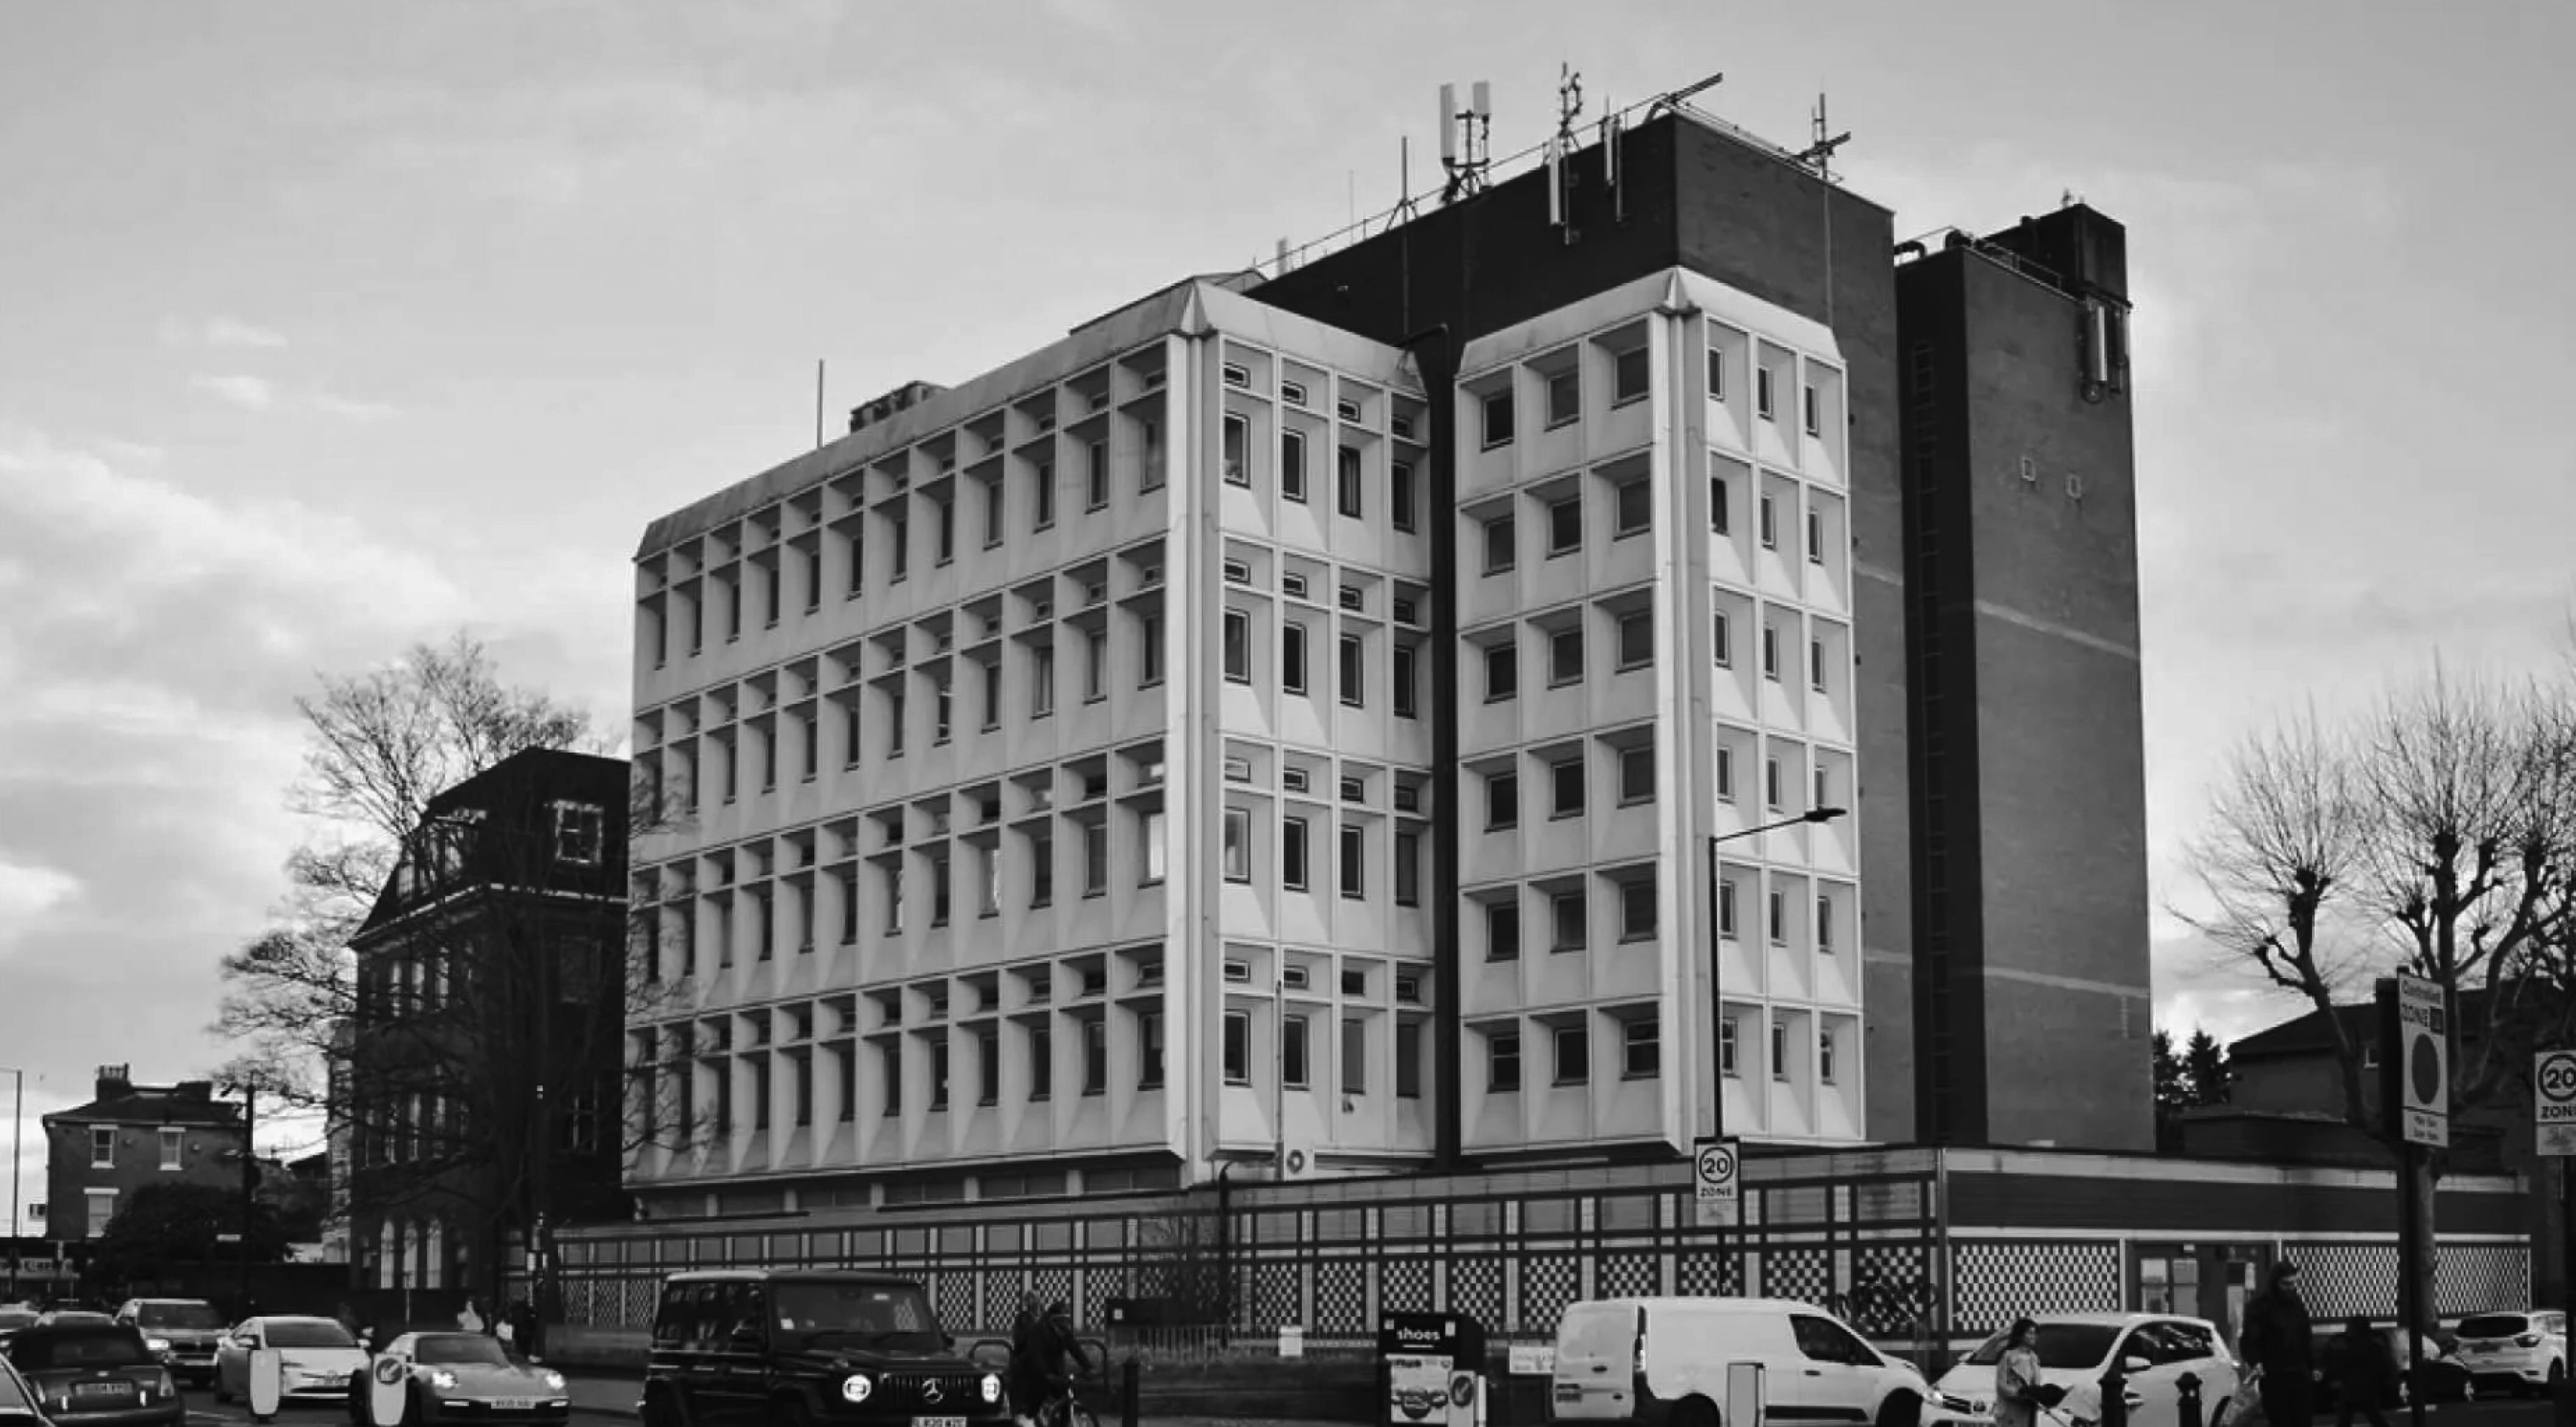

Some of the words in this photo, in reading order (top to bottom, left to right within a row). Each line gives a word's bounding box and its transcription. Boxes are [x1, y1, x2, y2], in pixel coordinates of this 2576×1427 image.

[2546, 1068, 2576, 1089] 20
[1705, 1157, 1728, 1173] 20
[1397, 1326, 1440, 1340] shoes
